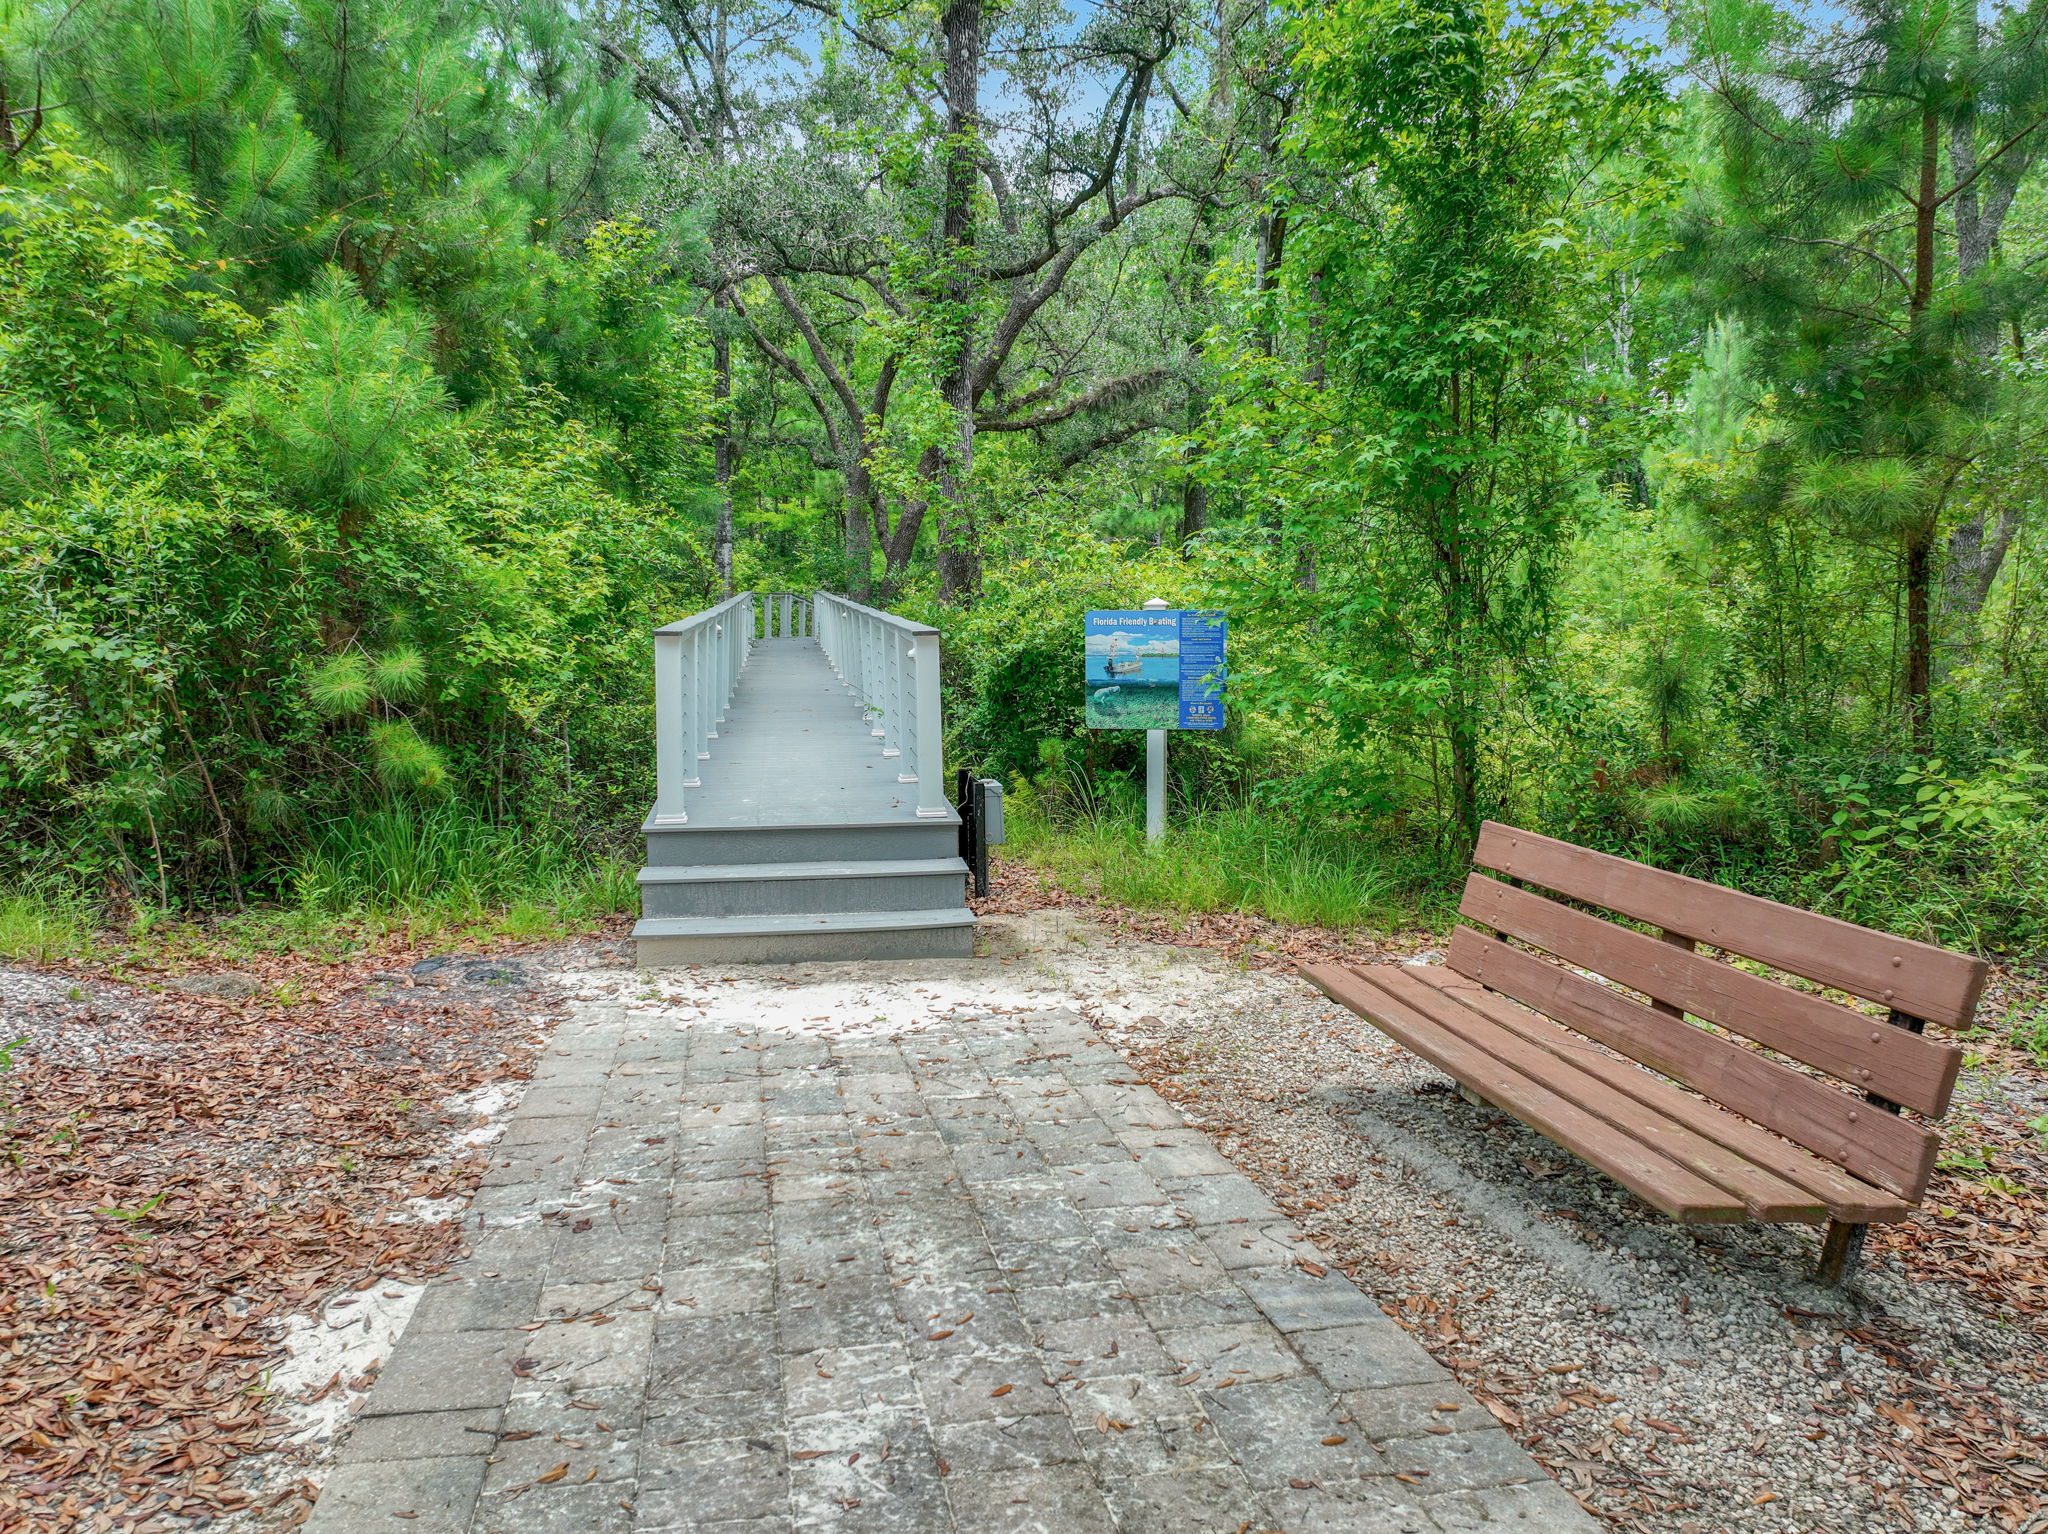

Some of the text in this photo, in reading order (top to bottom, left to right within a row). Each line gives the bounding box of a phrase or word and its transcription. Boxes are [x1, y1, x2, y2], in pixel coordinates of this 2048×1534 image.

[1093, 617, 1177, 627] Florida Friendly Bating
